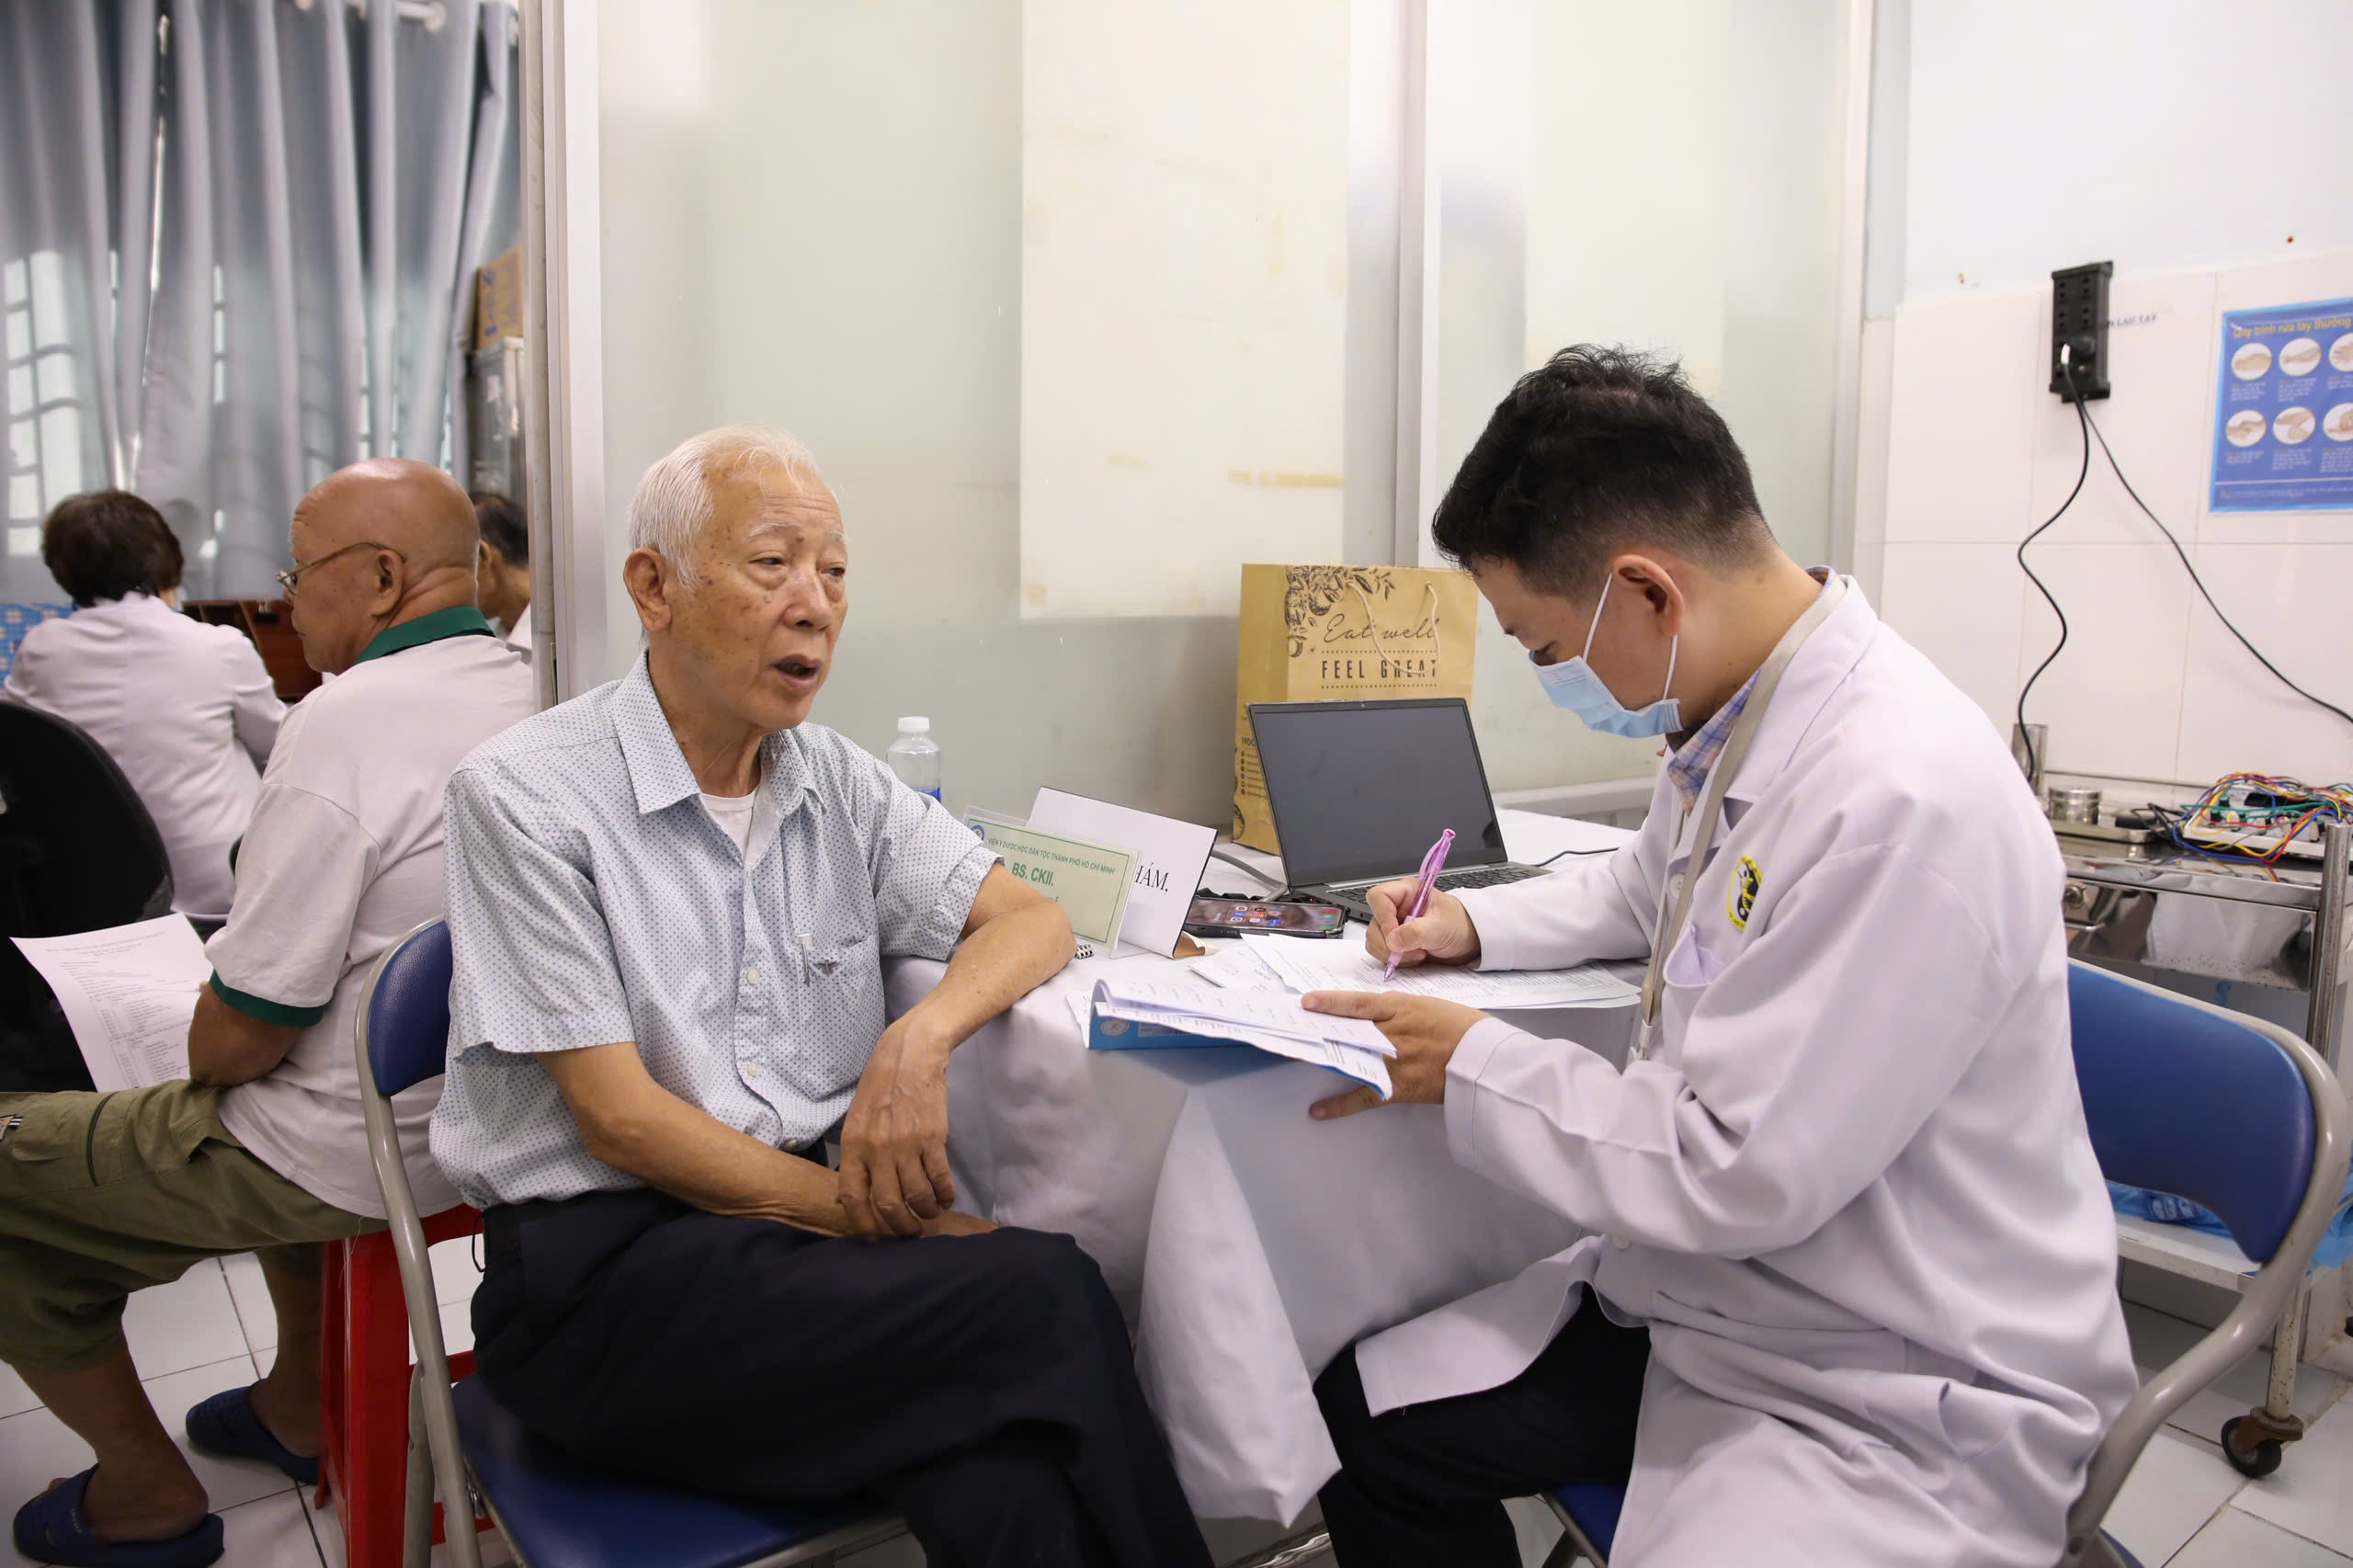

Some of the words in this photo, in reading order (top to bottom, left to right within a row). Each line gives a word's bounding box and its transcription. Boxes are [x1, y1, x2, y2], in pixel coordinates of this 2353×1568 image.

[1324, 613, 1375, 642] Eat
[1382, 618, 1439, 639] well
[1322, 660, 1365, 678] FEEL
[1381, 658, 1436, 678] GREAT
[1011, 862, 1028, 879] BS.
[1030, 867, 1054, 887] CKII.
[1100, 864, 1115, 875] MINH
